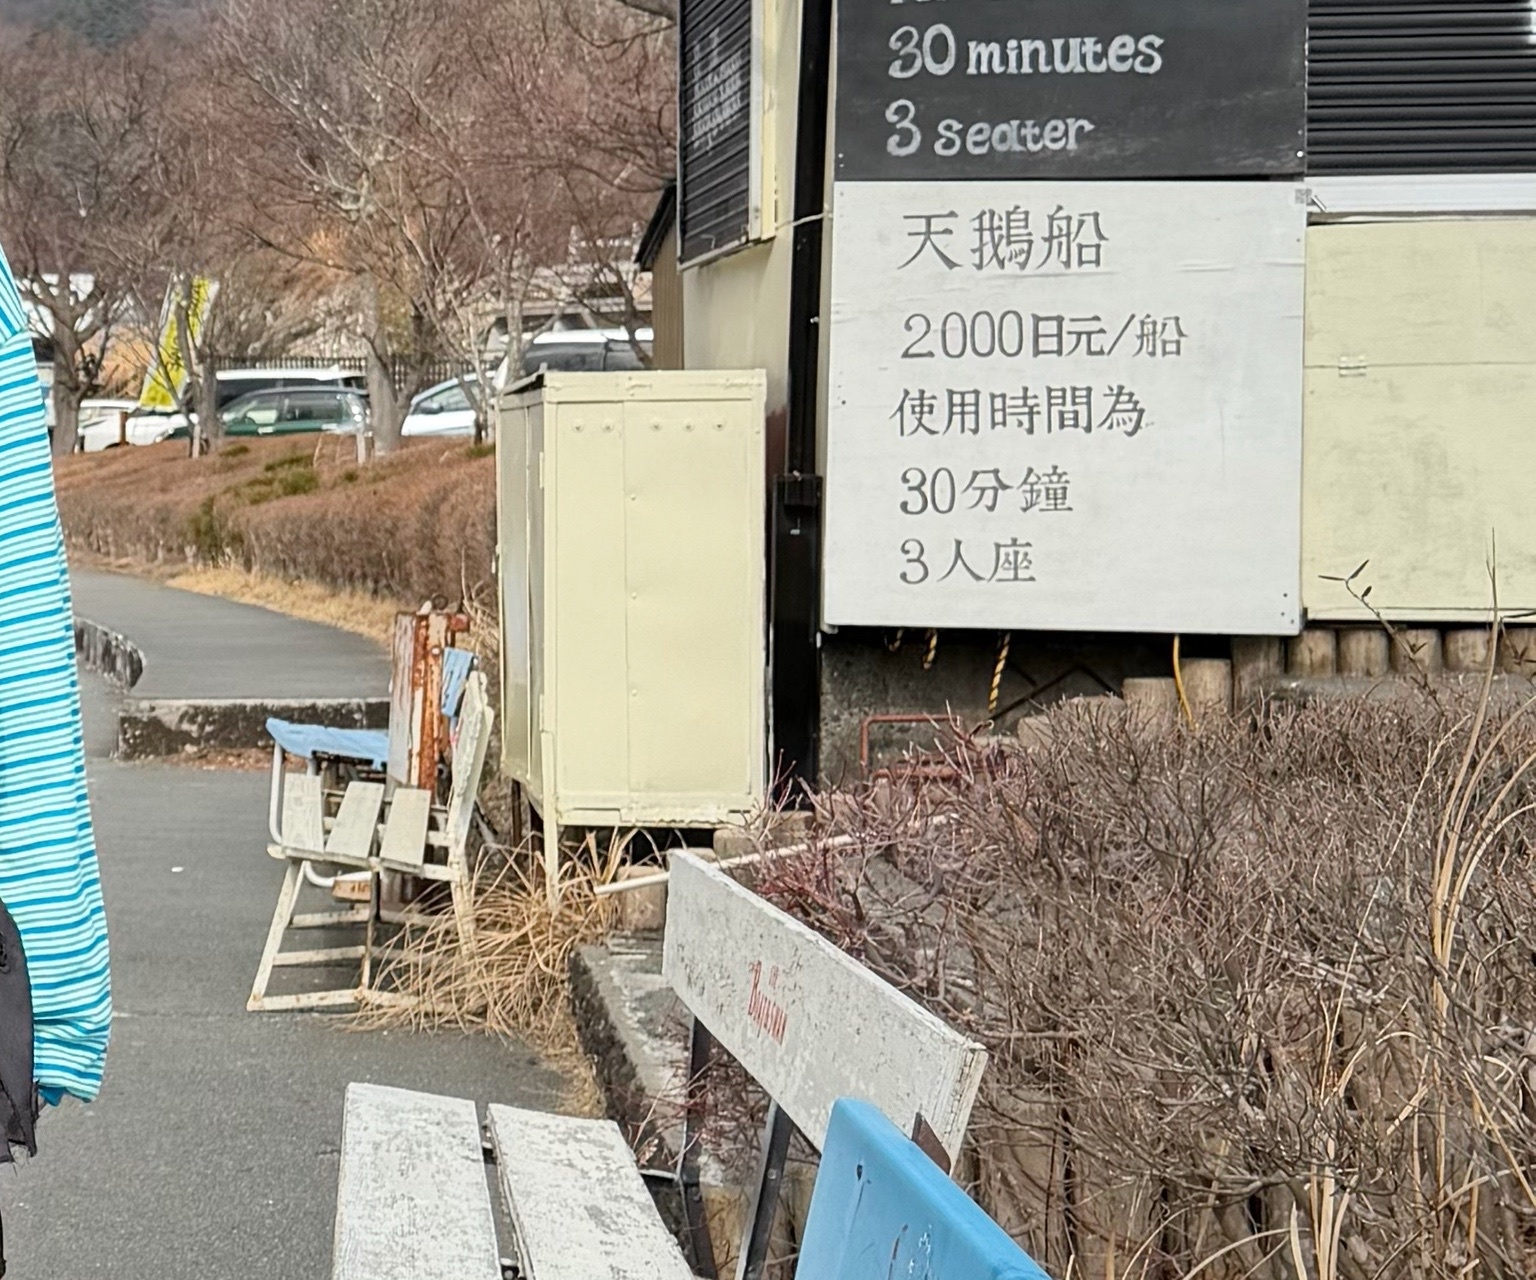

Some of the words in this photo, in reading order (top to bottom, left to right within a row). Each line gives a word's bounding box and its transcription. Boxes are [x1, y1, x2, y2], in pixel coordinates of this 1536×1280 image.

[888, 23, 956, 79] 30
[966, 34, 1165, 75] minutes
[885, 98, 922, 157] 3
[933, 117, 1095, 157] seater
[898, 204, 1109, 271] 天鵝船
[900, 309, 1188, 359] 2000日元/船
[889, 384, 1146, 438] 使用時間為
[899, 464, 1074, 516] 30分鐘
[899, 537, 1037, 585] 3人座
